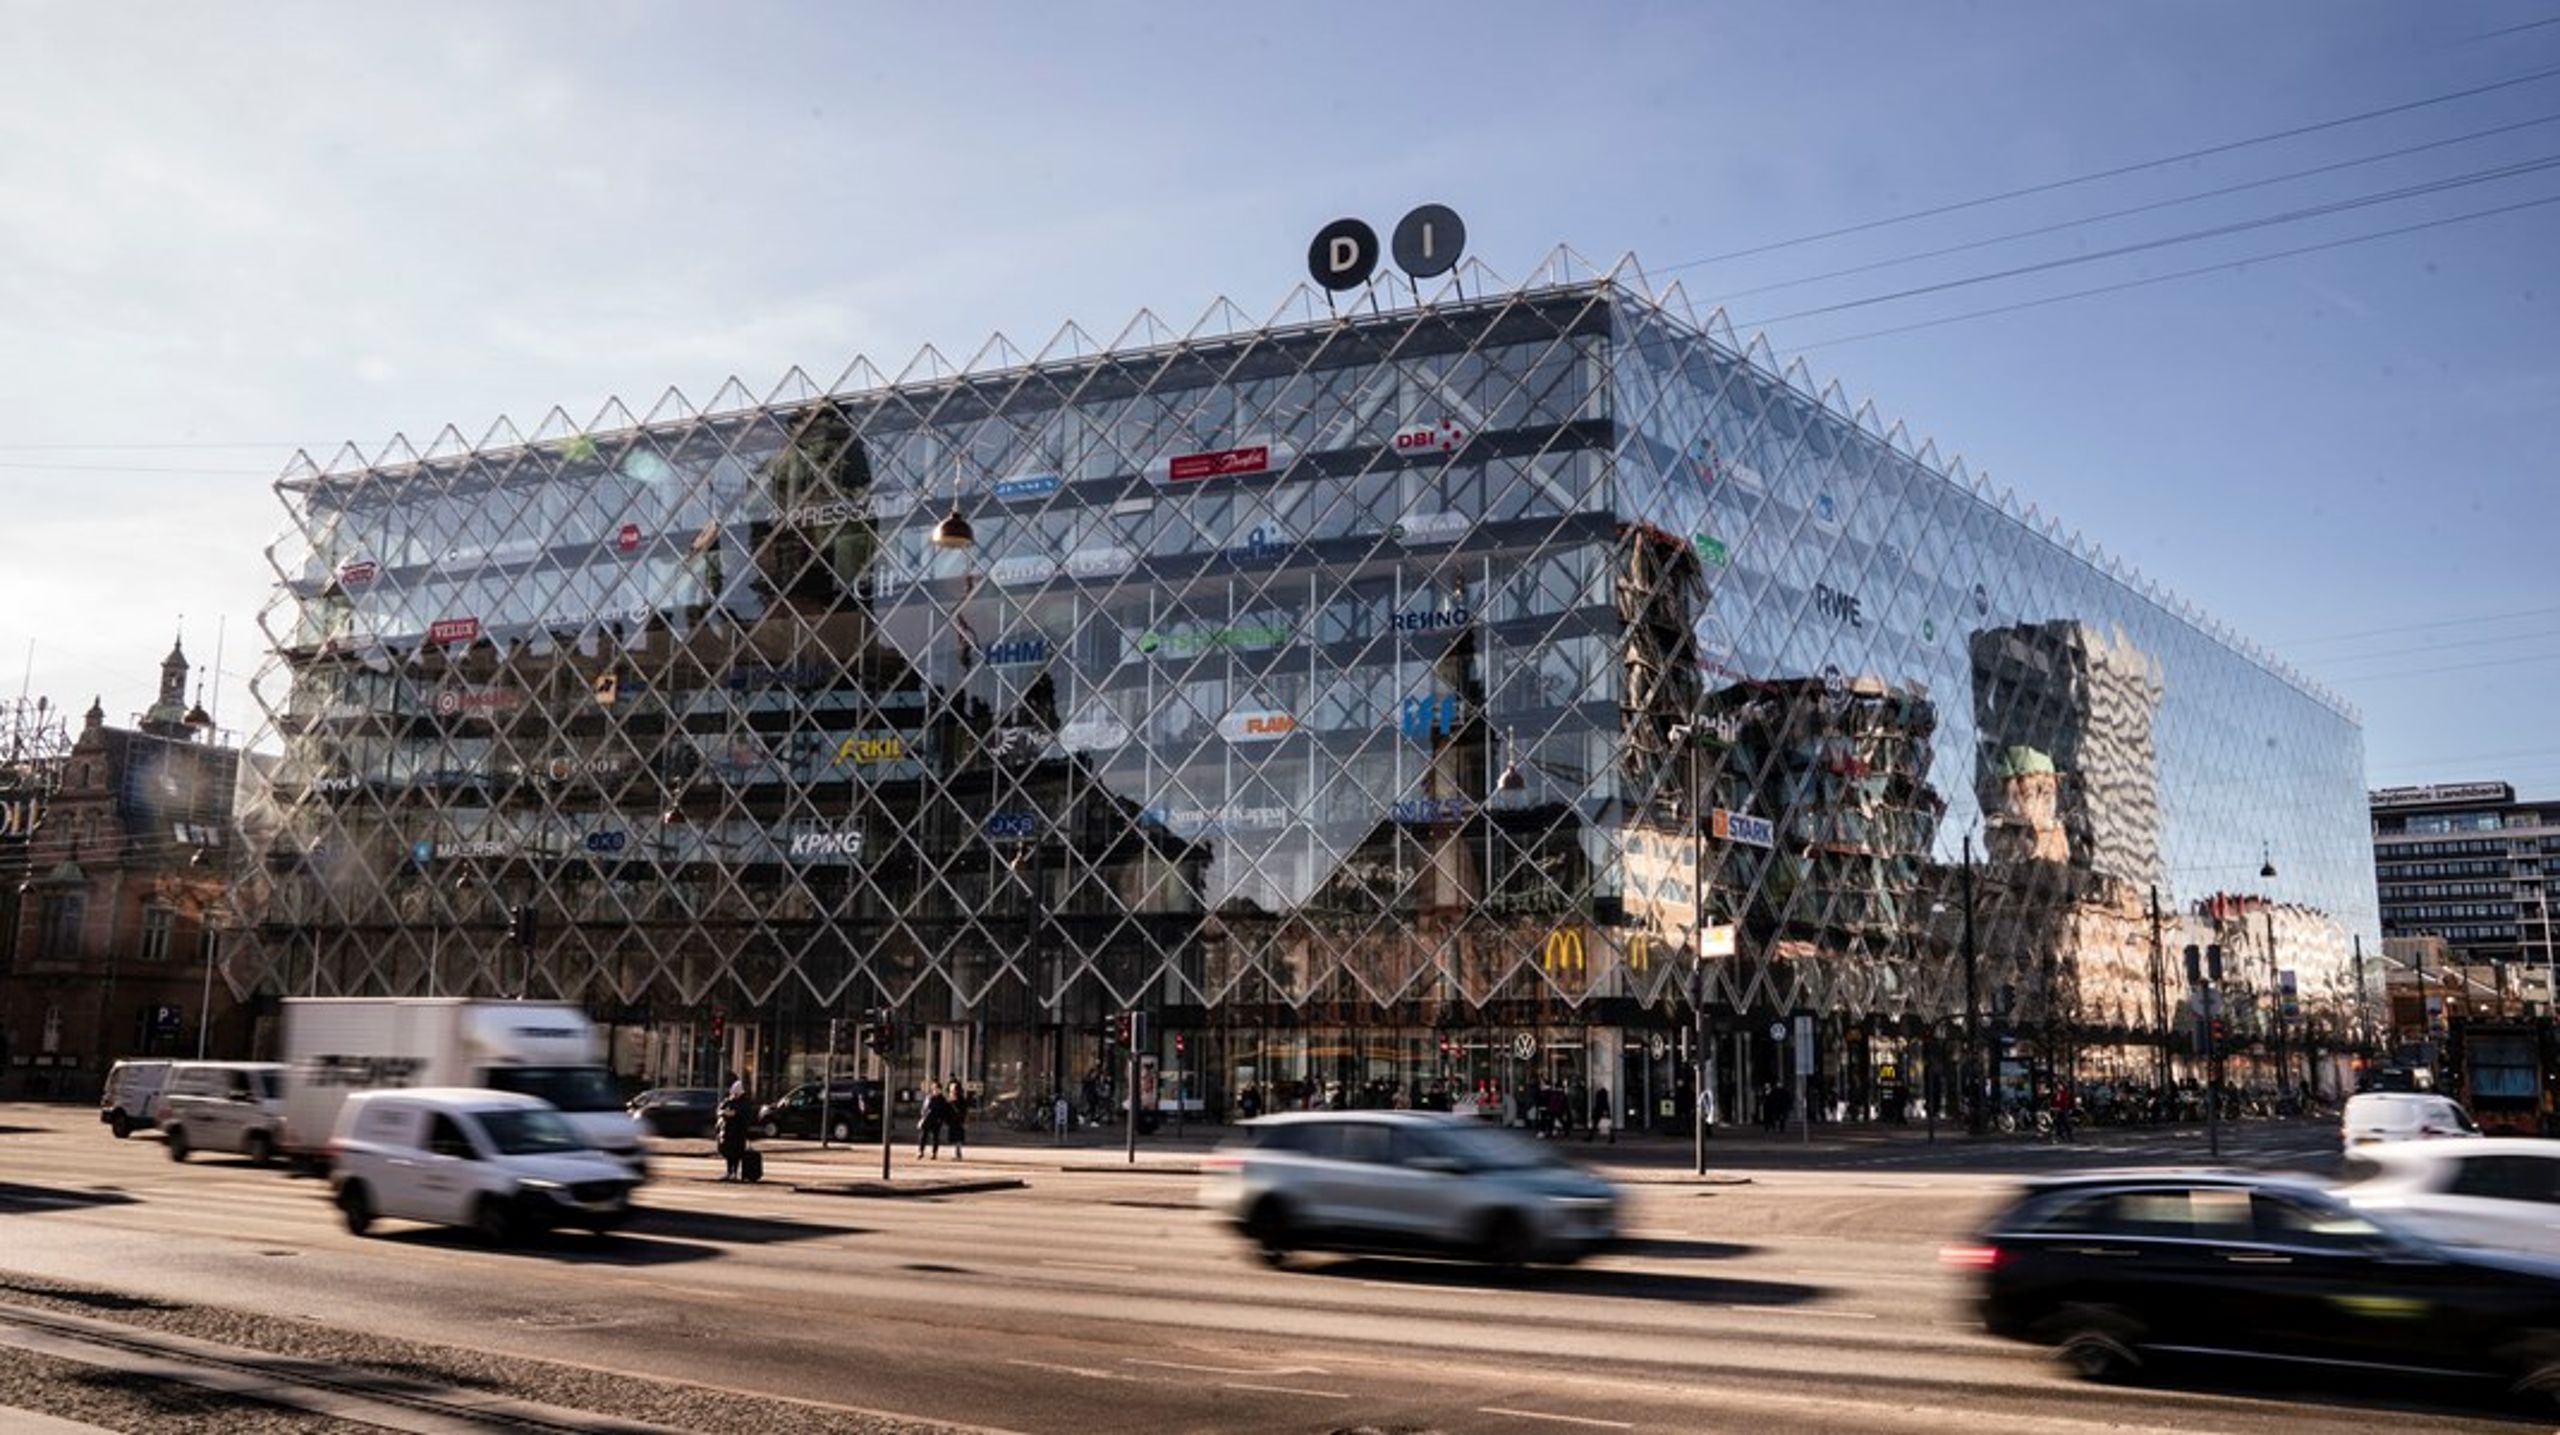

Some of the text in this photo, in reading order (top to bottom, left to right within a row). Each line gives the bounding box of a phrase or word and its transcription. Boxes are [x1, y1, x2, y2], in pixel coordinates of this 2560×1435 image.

[1329, 222, 1433, 273] D I
[1397, 432, 1434, 448] DBI
[1815, 582, 1862, 628] RWE
[434, 625, 474, 638] VELUX
[790, 831, 862, 854] KPMG
